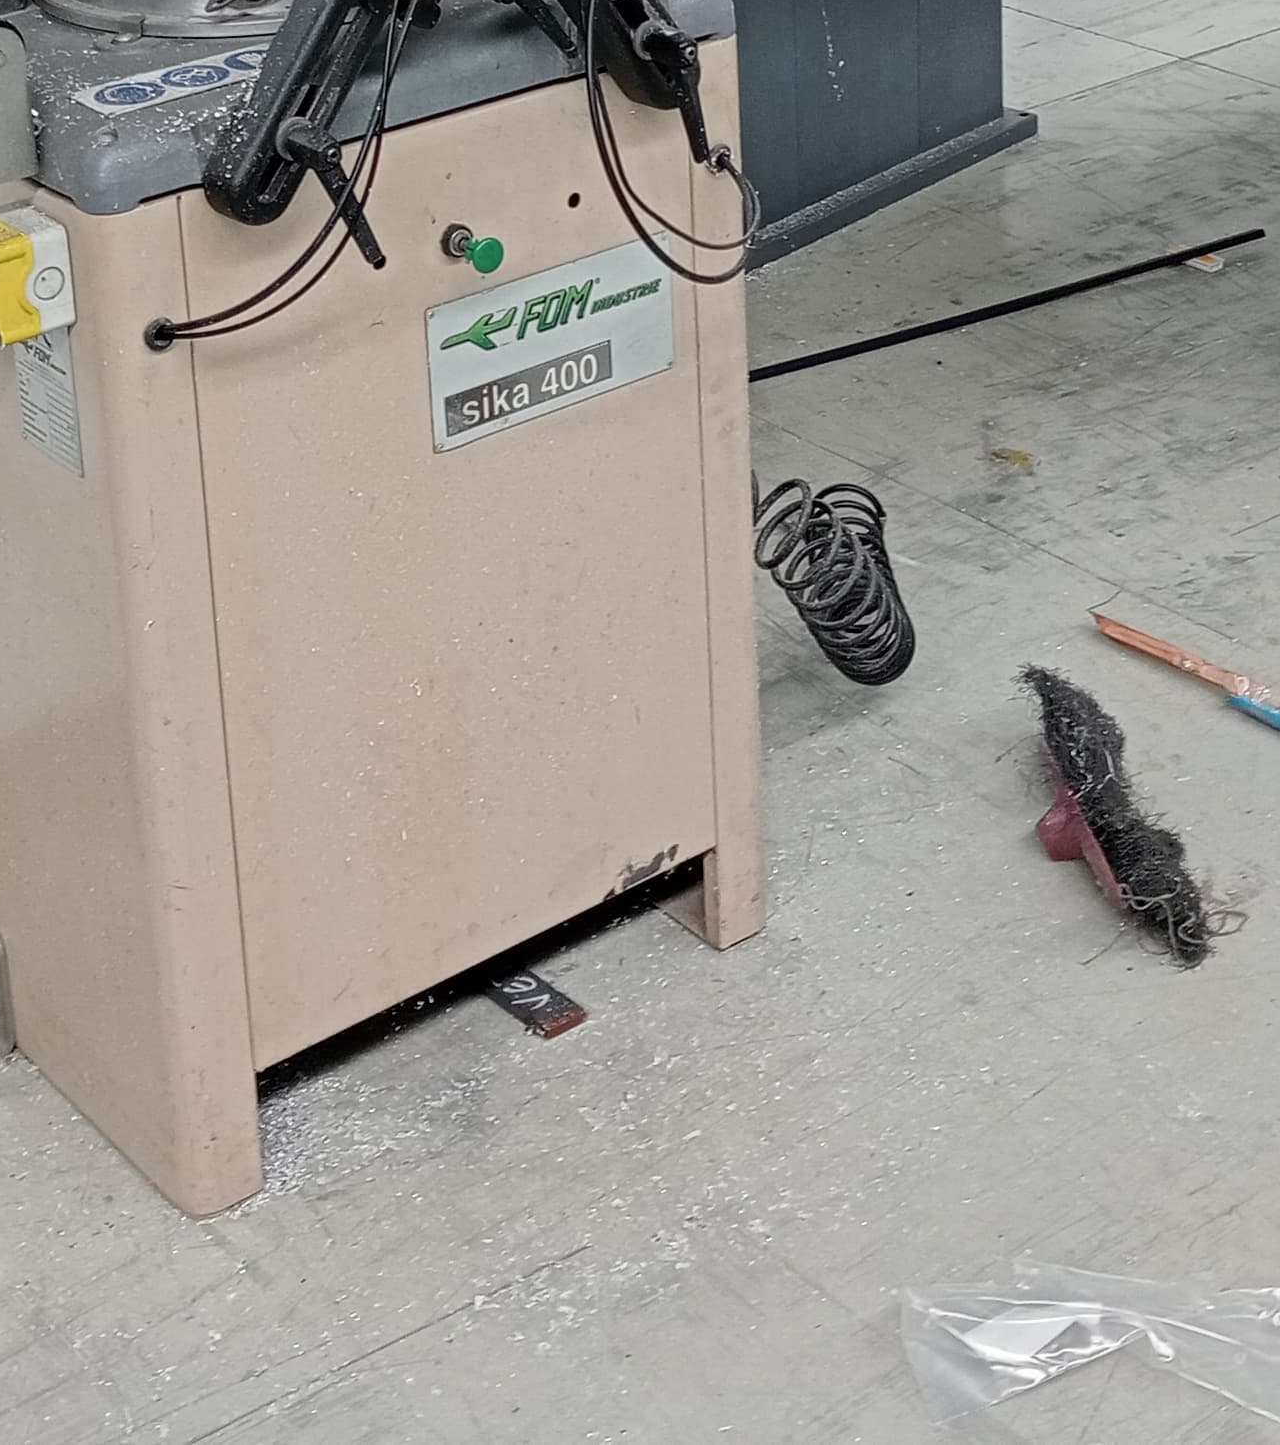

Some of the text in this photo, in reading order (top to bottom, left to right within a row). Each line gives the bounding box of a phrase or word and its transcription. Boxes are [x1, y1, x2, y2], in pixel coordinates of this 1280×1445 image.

[516, 278, 662, 341] FOM INDUSTRIE
[461, 353, 599, 426] sika 400
